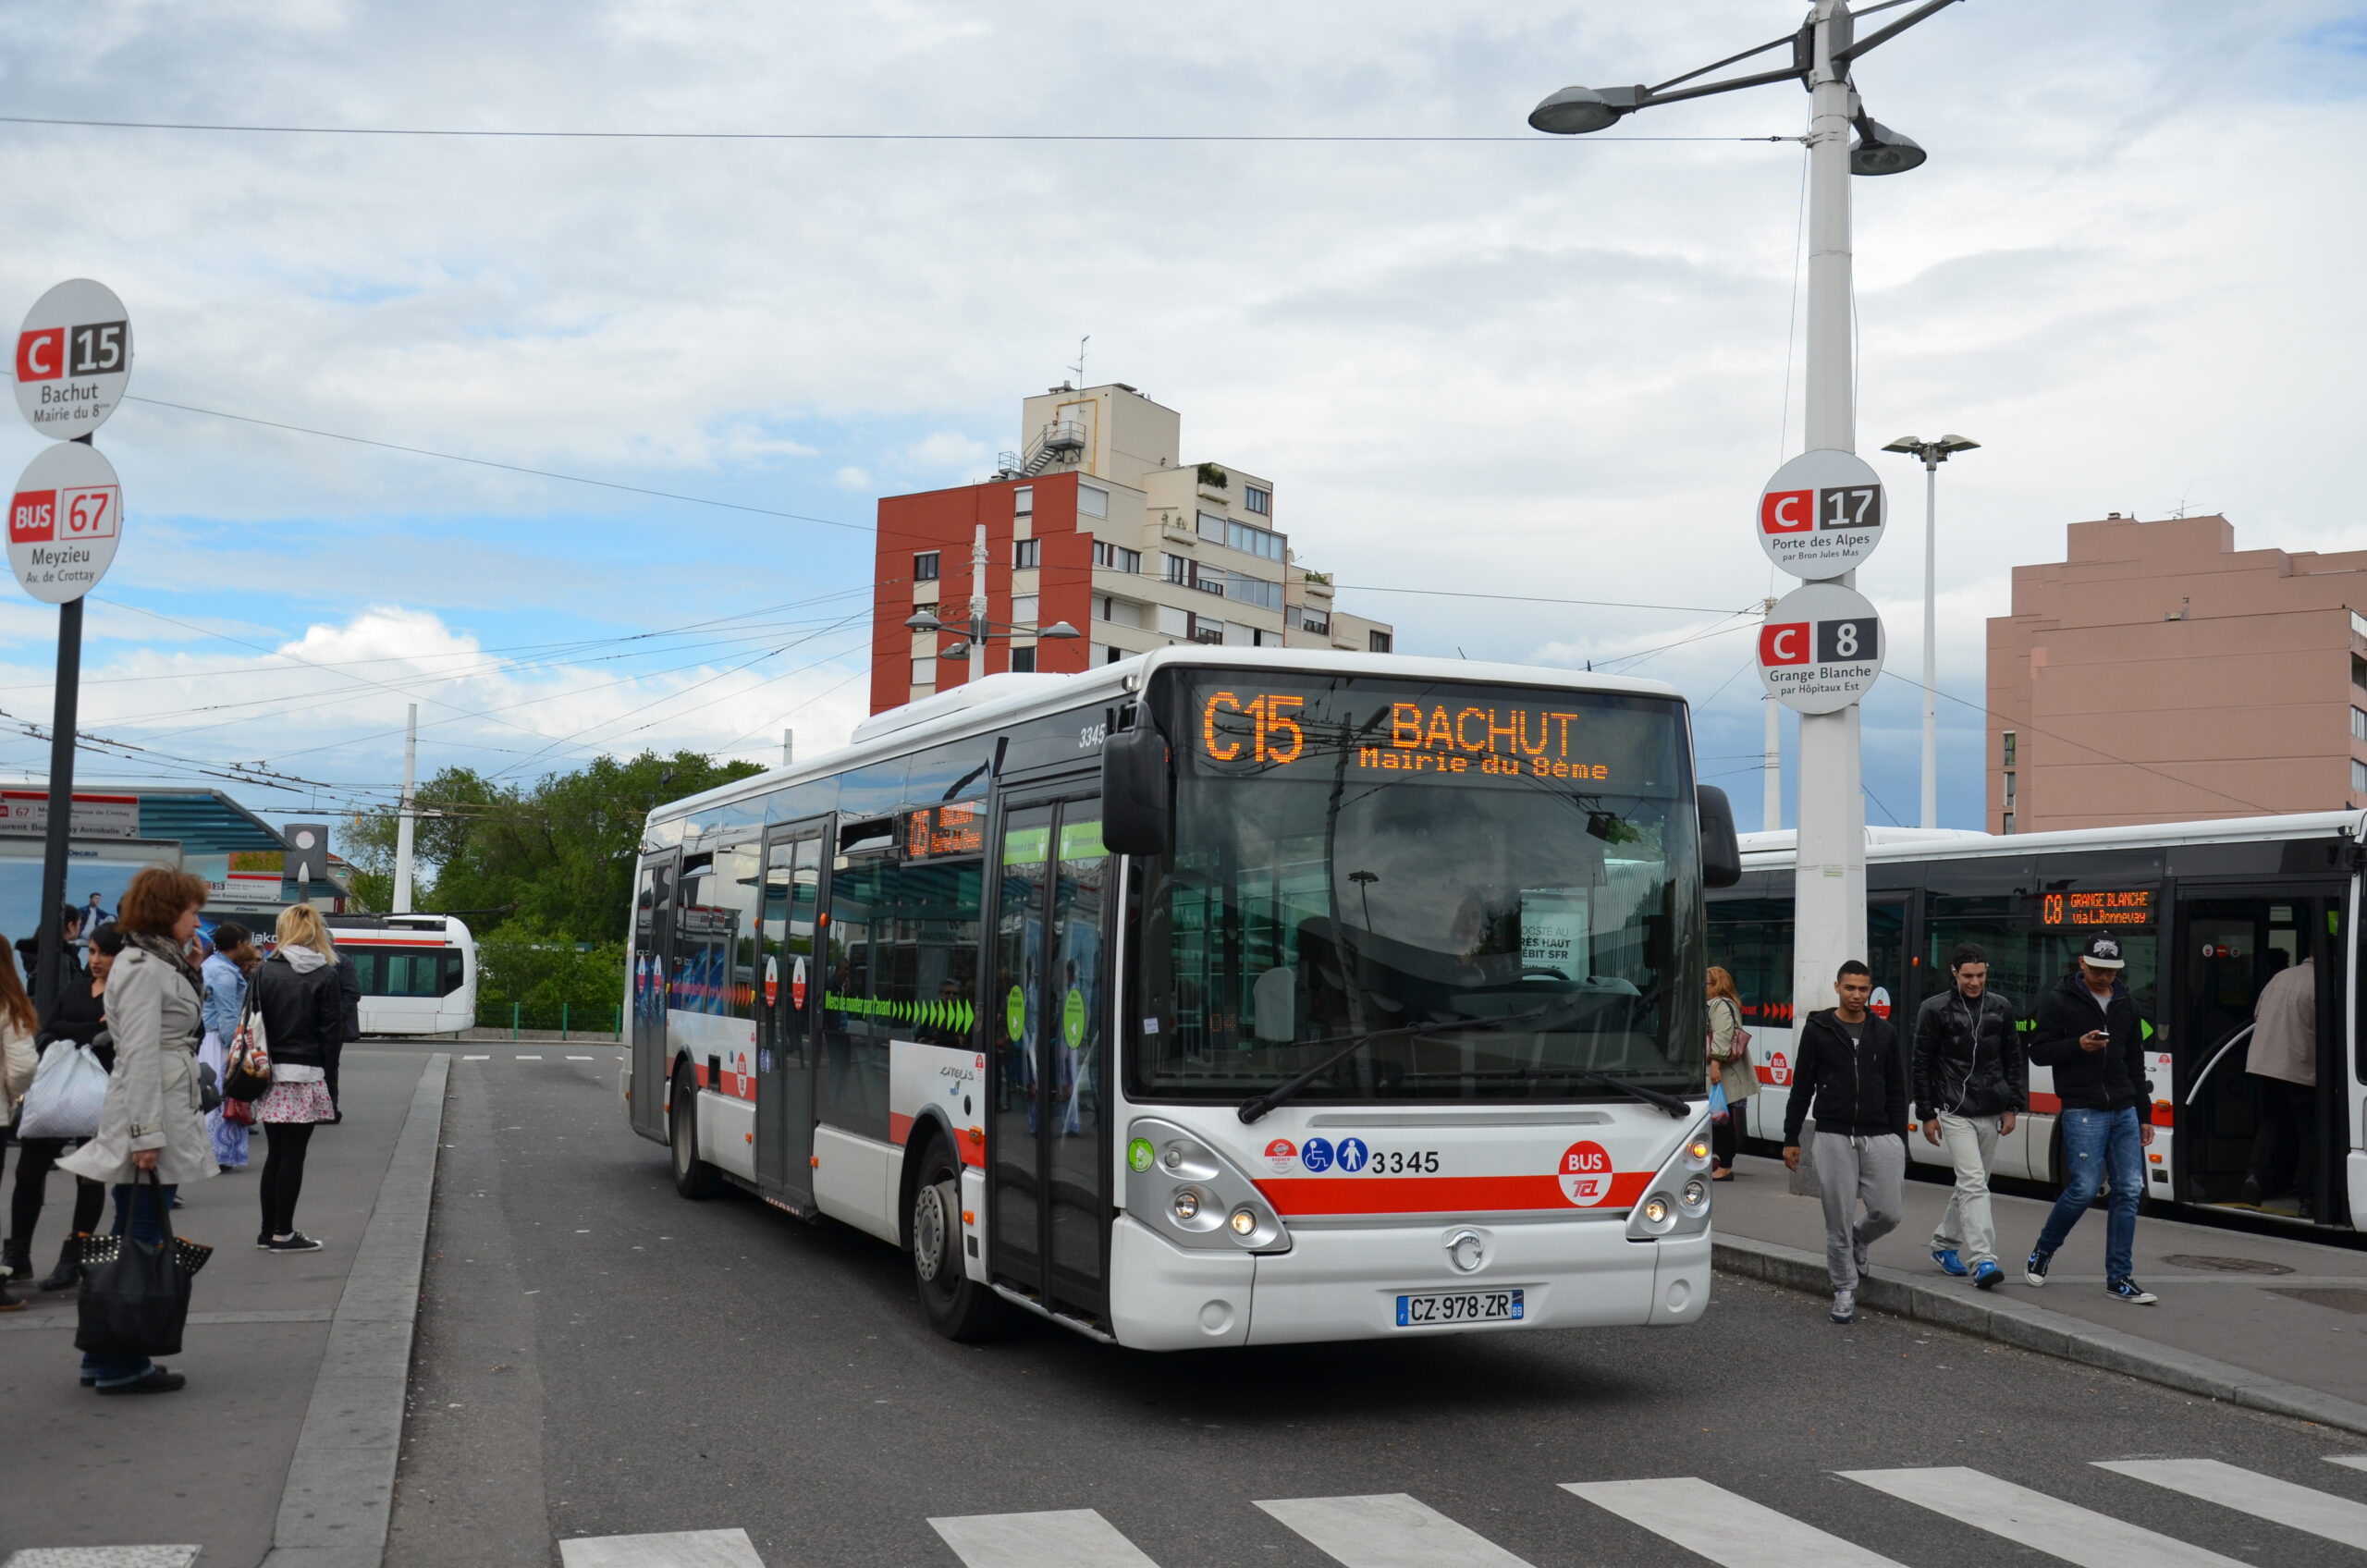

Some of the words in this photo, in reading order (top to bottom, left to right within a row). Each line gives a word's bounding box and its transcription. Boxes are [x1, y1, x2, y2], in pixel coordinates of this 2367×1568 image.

[28, 336, 52, 374] C
[77, 326, 121, 372] 15
[42, 383, 99, 404] Bachut
[34, 408, 69, 423] Mairie
[74, 406, 88, 419] du
[15, 504, 51, 529] BUS
[69, 493, 109, 533] 67
[1774, 496, 1799, 527] C
[1828, 489, 1873, 525] 17
[1772, 538, 1806, 550] Porte
[1810, 535, 1831, 548] des
[1836, 533, 1870, 548] Alpes
[31, 547, 91, 569] Meyzieu
[1783, 553, 1796, 562] par
[1798, 551, 1818, 560] Bron
[1820, 550, 1840, 559] Jules
[1843, 548, 1859, 557] Mas
[26, 572, 40, 583] Av.
[43, 570, 55, 582] de
[58, 569, 94, 583] Crottay
[1773, 629, 1797, 659] C
[1836, 623, 1858, 657] 8
[1770, 668, 1815, 683] Grange
[1820, 666, 1871, 680] Blanche
[1781, 687, 1797, 697] par
[1798, 683, 1841, 696] Hôpitaux
[1845, 682, 1859, 692] Est
[1079, 723, 1106, 748] 3345
[1205, 692, 1303, 764] C15
[1393, 702, 1578, 757] BACHUT
[1360, 747, 1468, 773] Mairie
[1482, 754, 1519, 775] du
[1532, 756, 1609, 779] 8ème
[15, 807, 30, 816] 67
[2071, 893, 2105, 908] GRANGE
[2106, 891, 2150, 907] BLANCHE
[2044, 894, 2063, 925] C8
[2072, 910, 2089, 924] via
[1555, 927, 1569, 937] AU
[1542, 938, 1572, 949] HAUT
[1548, 949, 1568, 960] SFR
[1773, 1058, 1784, 1066] BUS
[1372, 1151, 1440, 1174] 3345
[1568, 1153, 1602, 1171] BUS
[1411, 1294, 1509, 1321] CZ-978-ZR
[1513, 1305, 1523, 1317] 69
